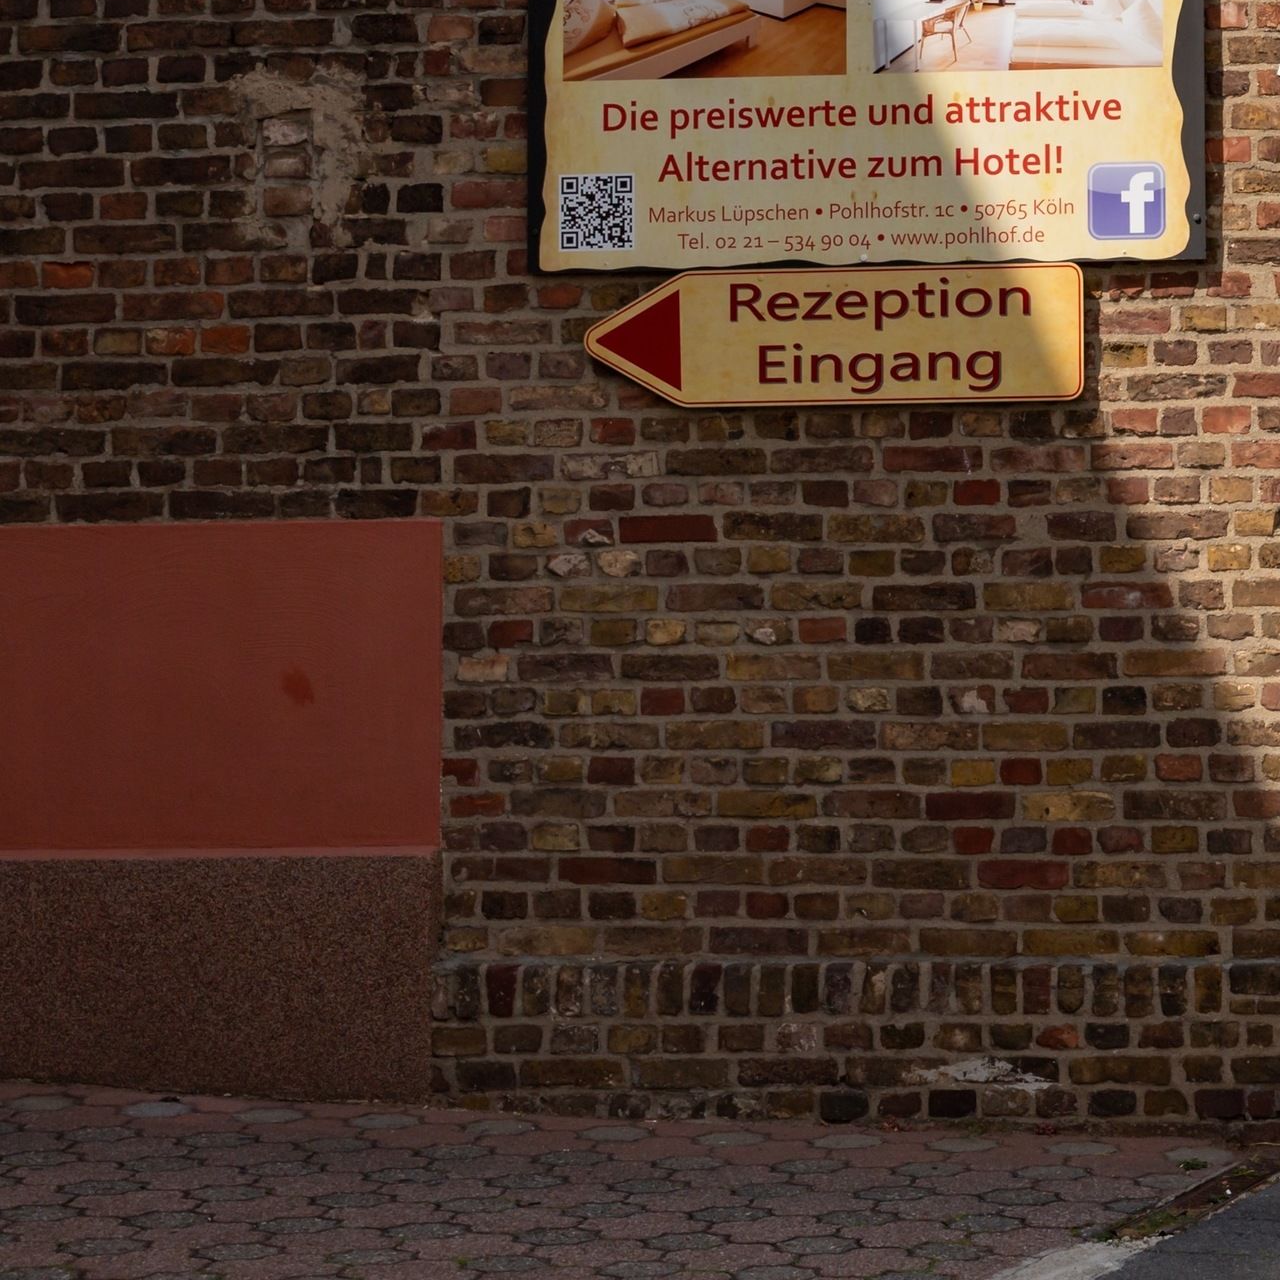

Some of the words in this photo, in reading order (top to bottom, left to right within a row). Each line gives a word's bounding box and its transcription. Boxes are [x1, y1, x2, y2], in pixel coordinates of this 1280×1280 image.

[602, 102, 659, 133] Die
[669, 98, 857, 140] preiswerte
[867, 94, 935, 126] und
[944, 91, 1122, 125] attraktive
[658, 147, 857, 183] Alternative
[867, 154, 943, 179] zum
[953, 144, 1063, 176] Hotel!
[648, 205, 716, 224] Markus
[721, 203, 809, 226] Lüpschen
[829, 200, 929, 220] Pohlhofstr.
[973, 199, 1028, 221] 50765
[1033, 197, 1075, 216] Köln
[677, 232, 709, 250] Tel.
[715, 236, 736, 249] 02
[743, 236, 764, 249] 21
[784, 235, 816, 252] 534
[820, 234, 844, 251] 90
[848, 232, 872, 249] 04
[890, 225, 1046, 250] www.pohlhof.de
[729, 277, 1033, 331] Rezeption
[757, 342, 1003, 394] Eingang
